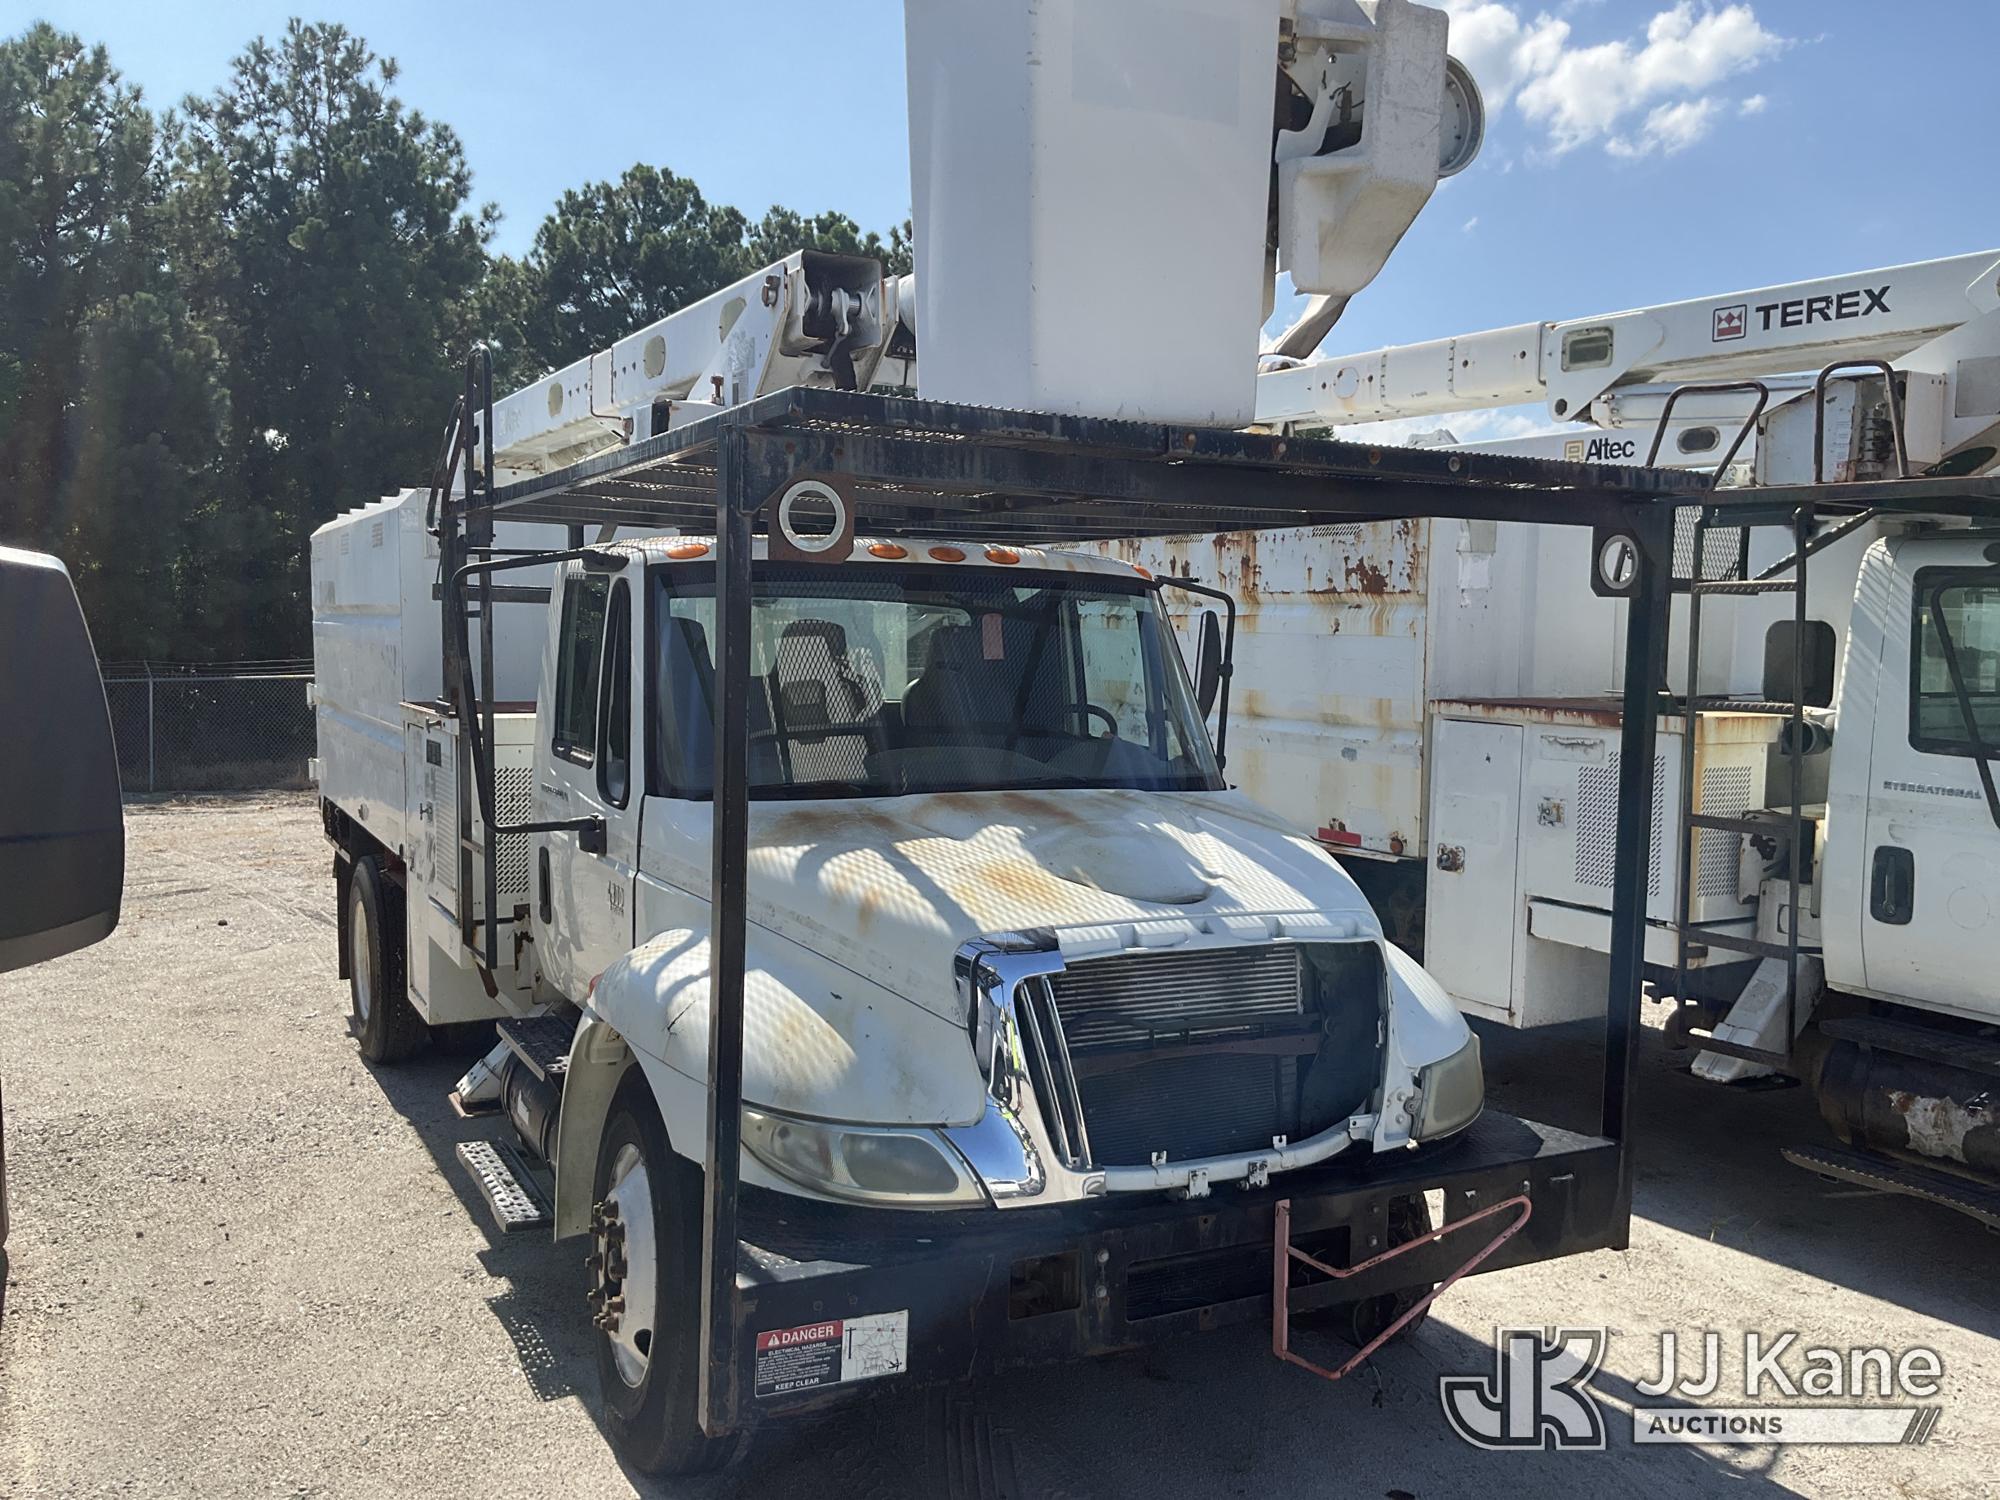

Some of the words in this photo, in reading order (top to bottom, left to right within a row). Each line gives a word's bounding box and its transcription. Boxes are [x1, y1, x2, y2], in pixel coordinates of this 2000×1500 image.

[1755, 285, 1891, 331] TEREX
[1585, 437, 1635, 462] Altec
[782, 1325, 834, 1344] DANGER
[801, 1341, 827, 1351] HAZARDS
[775, 1381, 794, 1391] KEEP
[796, 1377, 819, 1388] CLEAR
